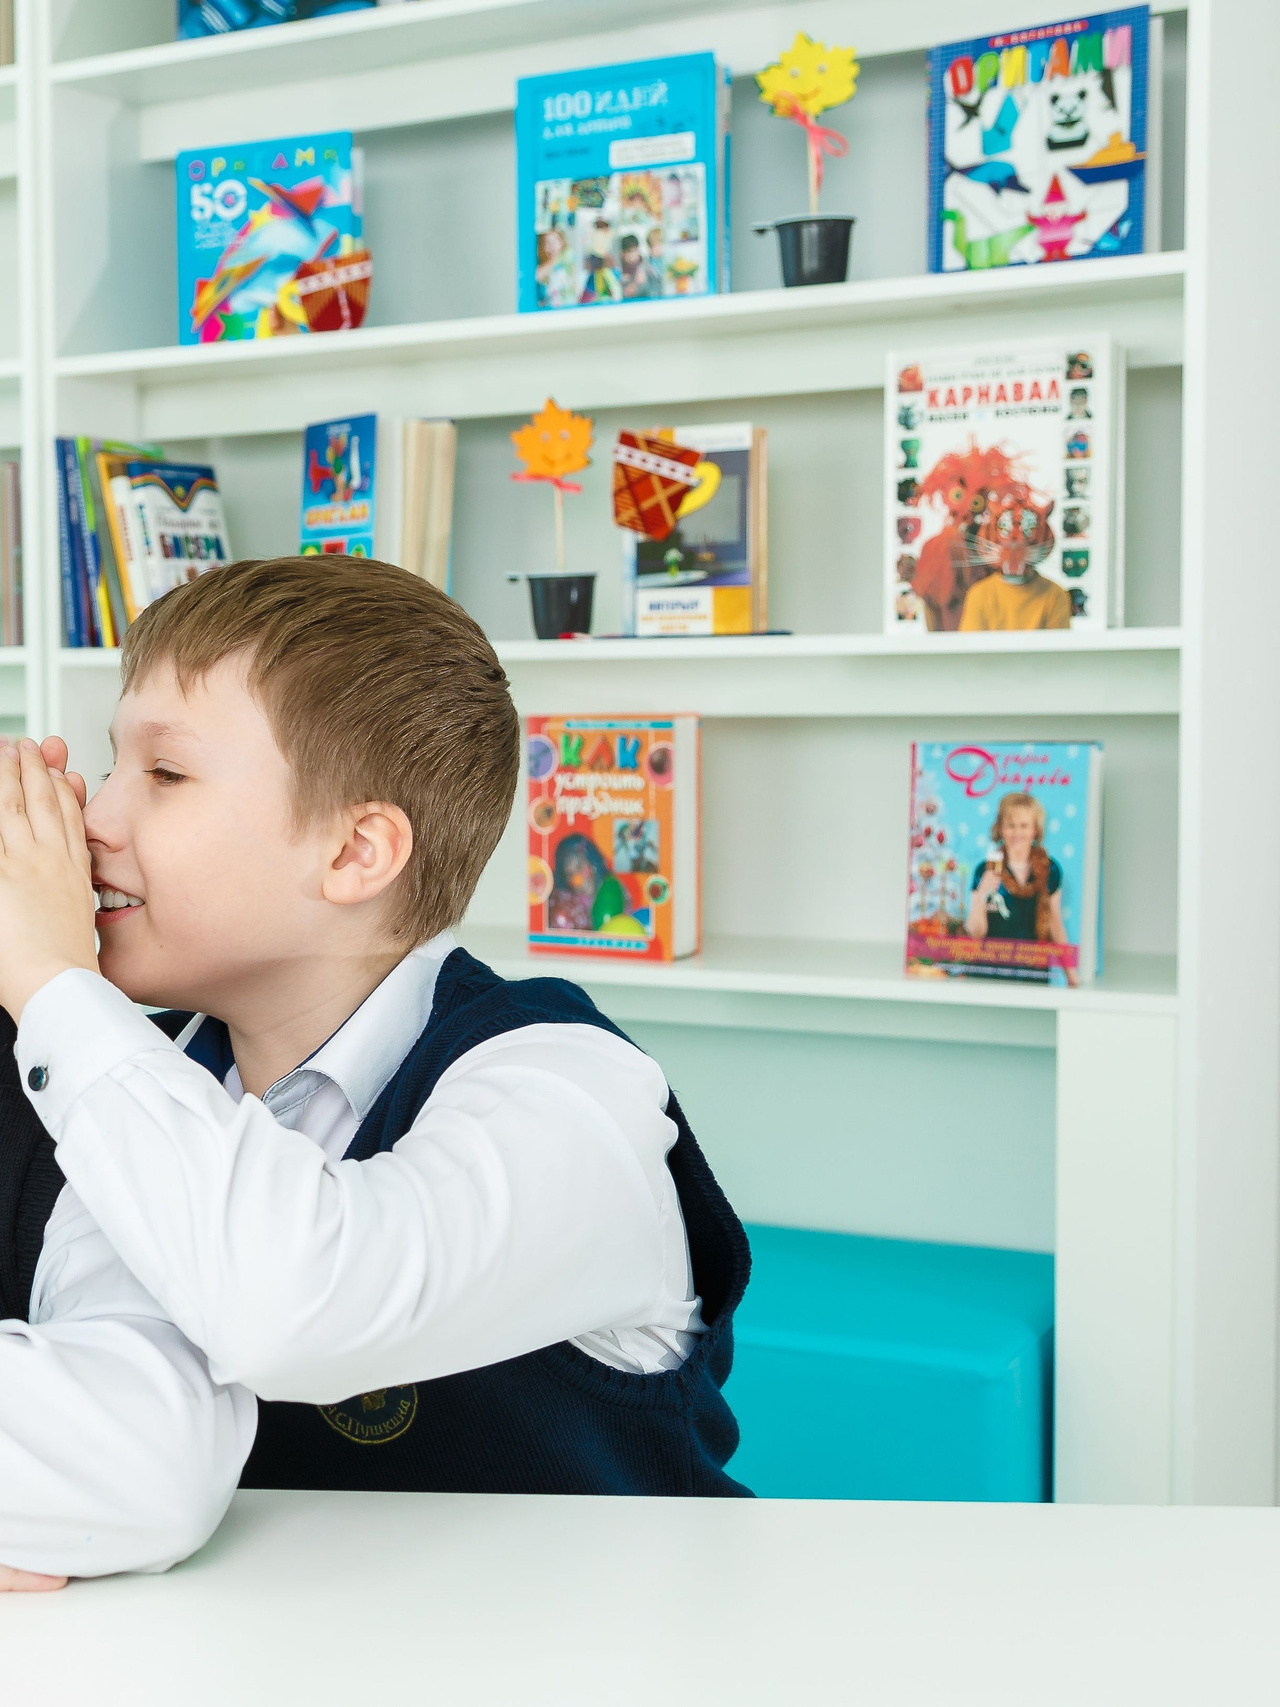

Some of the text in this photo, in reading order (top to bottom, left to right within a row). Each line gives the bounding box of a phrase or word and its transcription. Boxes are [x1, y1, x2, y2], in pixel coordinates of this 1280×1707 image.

[944, 25, 1132, 97] ОРИГАМИ
[543, 90, 593, 122] 100
[190, 178, 248, 222] 50
[927, 379, 1060, 408] КАРНАВАЛ
[560, 732, 642, 771] КАК
